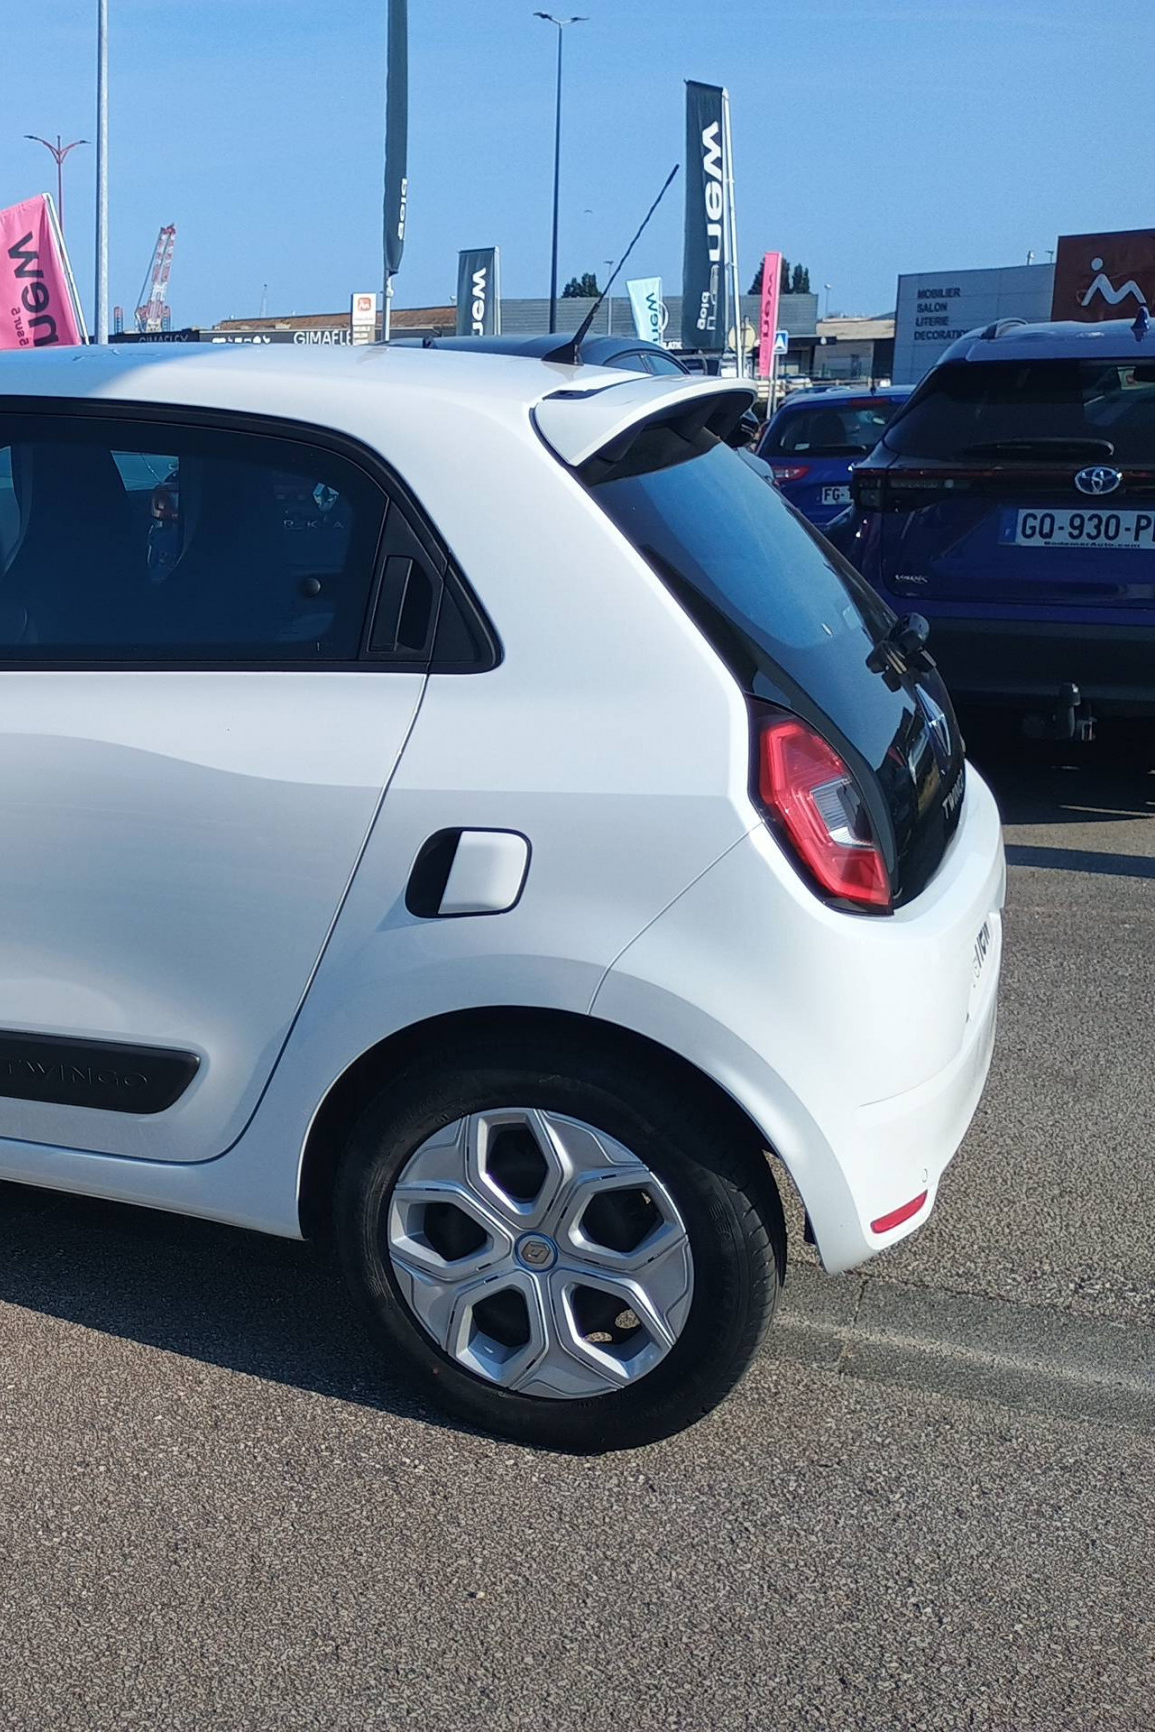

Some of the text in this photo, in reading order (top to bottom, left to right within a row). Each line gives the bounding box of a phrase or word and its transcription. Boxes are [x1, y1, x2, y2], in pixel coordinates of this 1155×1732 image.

[917, 287, 961, 299] MOBILIER
[917, 302, 948, 313] SALON
[293, 329, 352, 346] GIMAFLE
[1021, 513, 1155, 542] GQ-930-P
[7, 1058, 149, 1087] TWINGO
